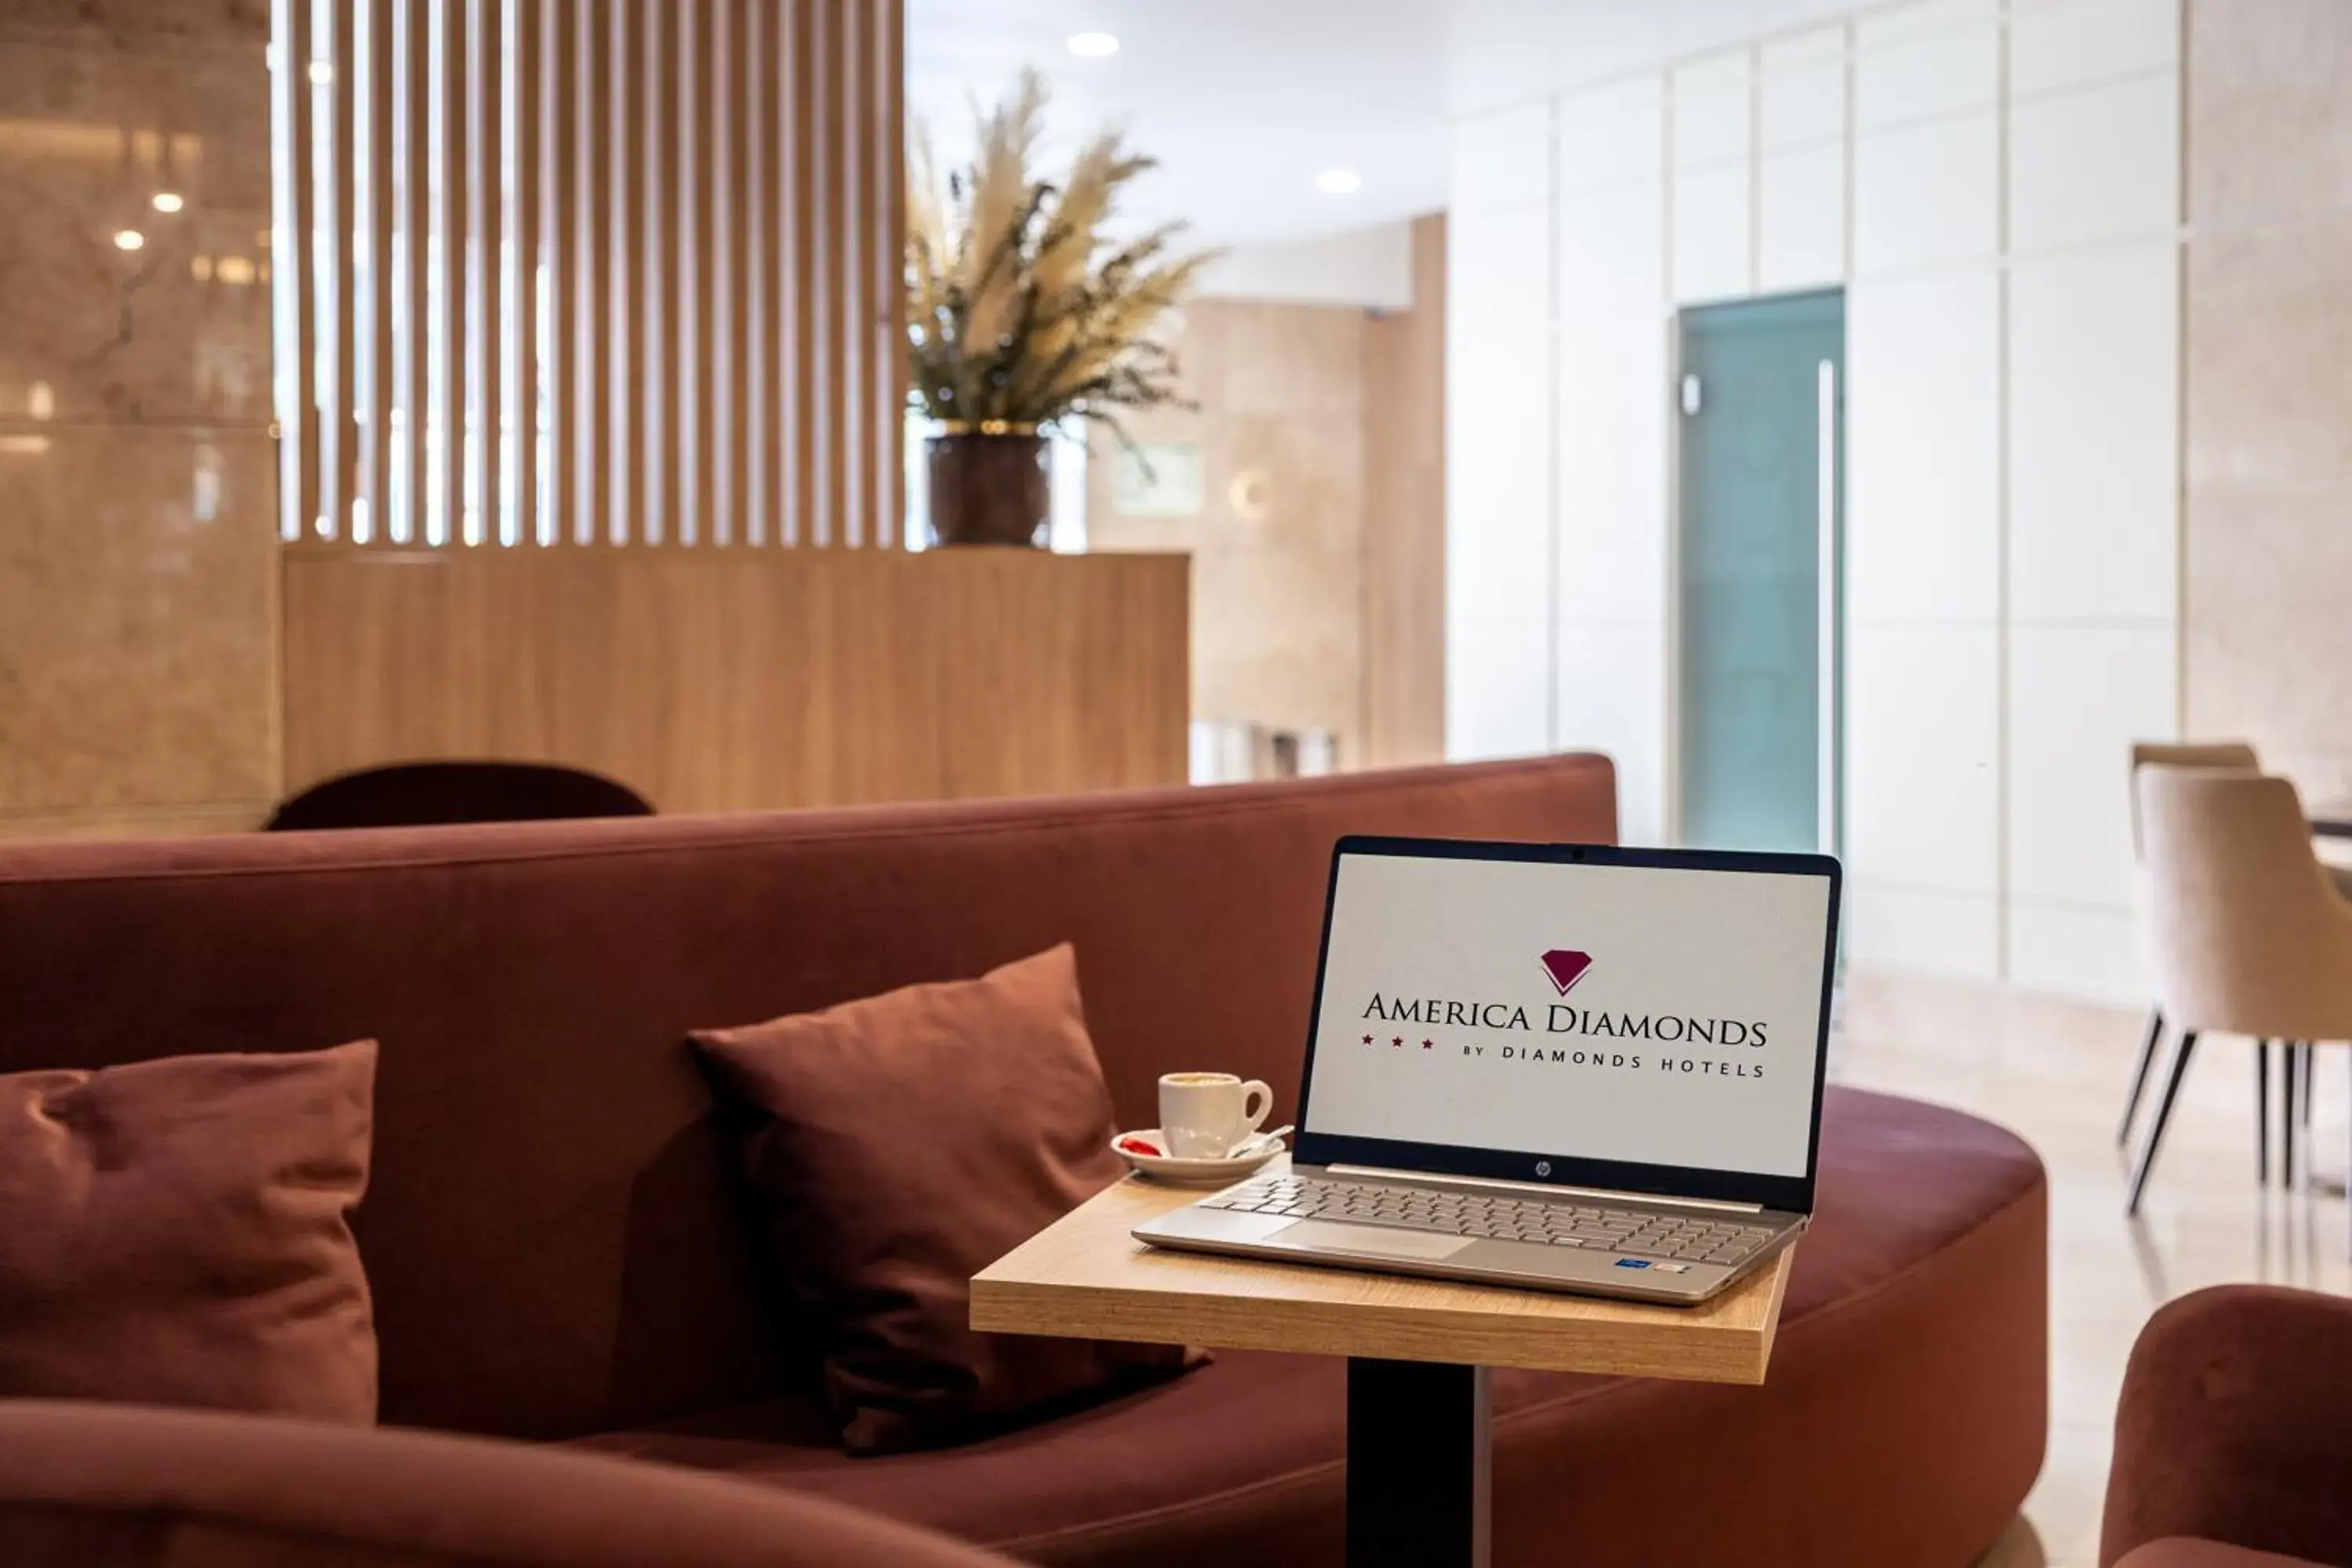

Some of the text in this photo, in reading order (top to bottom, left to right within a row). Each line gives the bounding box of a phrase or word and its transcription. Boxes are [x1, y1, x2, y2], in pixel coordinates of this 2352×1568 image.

[1360, 992, 1768, 1048] AMERICA DIAMONDS
[1463, 1045, 1763, 1078] BY DIAMONDS HOTELS
